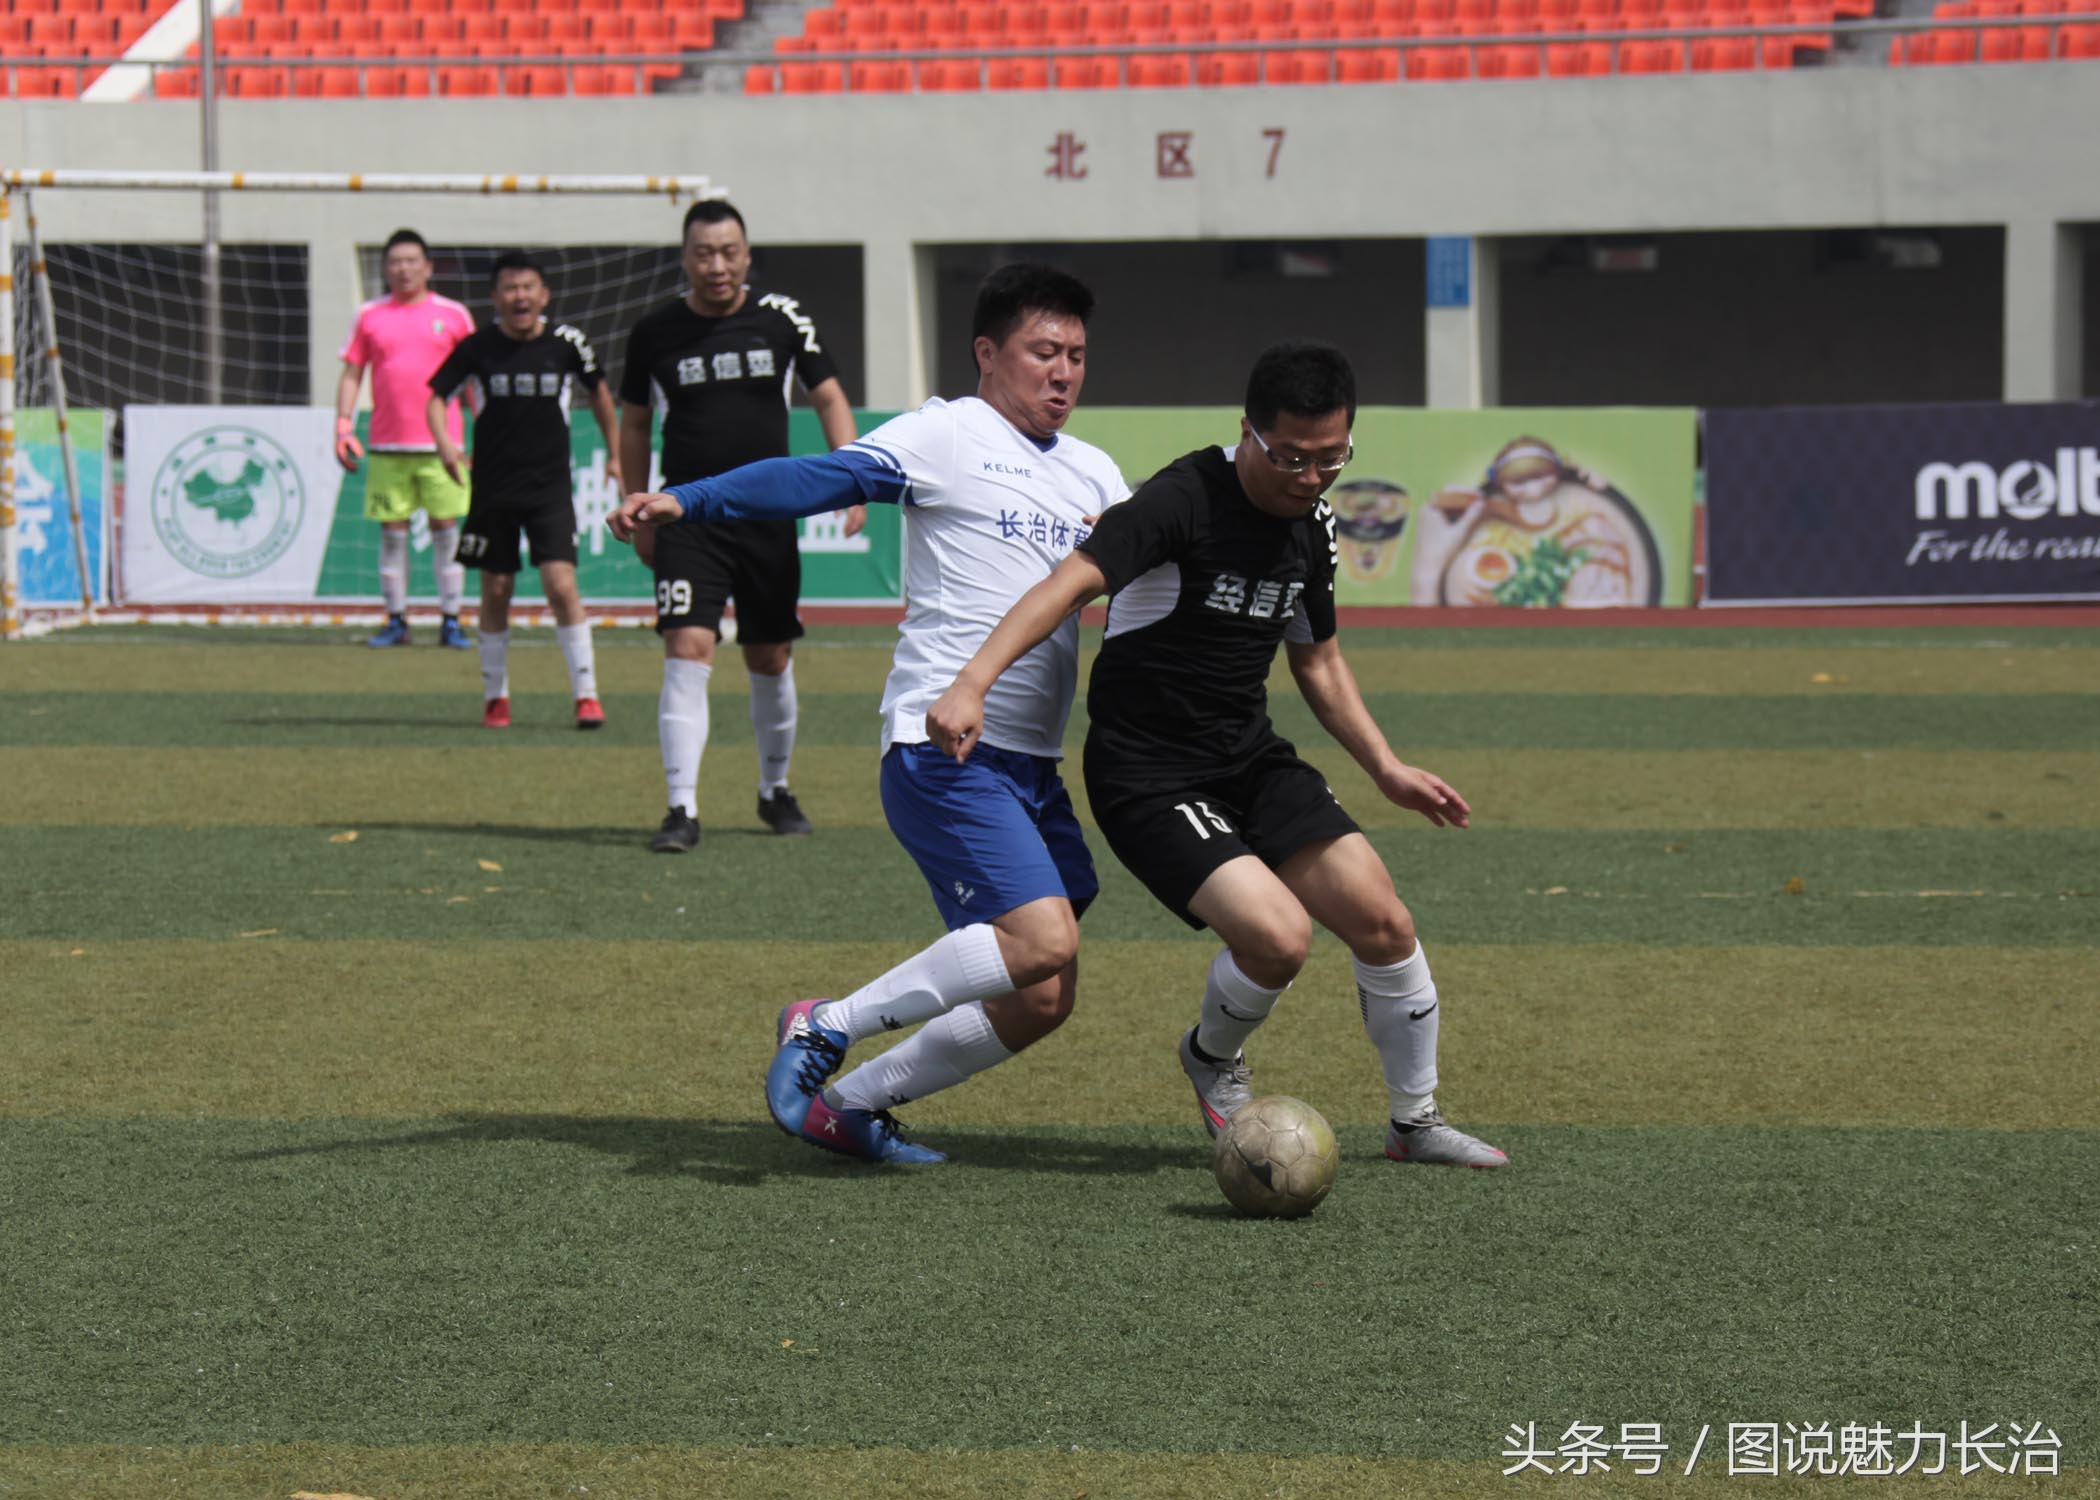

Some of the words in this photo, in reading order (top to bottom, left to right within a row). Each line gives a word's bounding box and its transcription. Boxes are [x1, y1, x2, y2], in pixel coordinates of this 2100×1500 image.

[983, 462, 1032, 479] KELME
[1904, 529, 1968, 566] For
[1969, 527, 2031, 561] the
